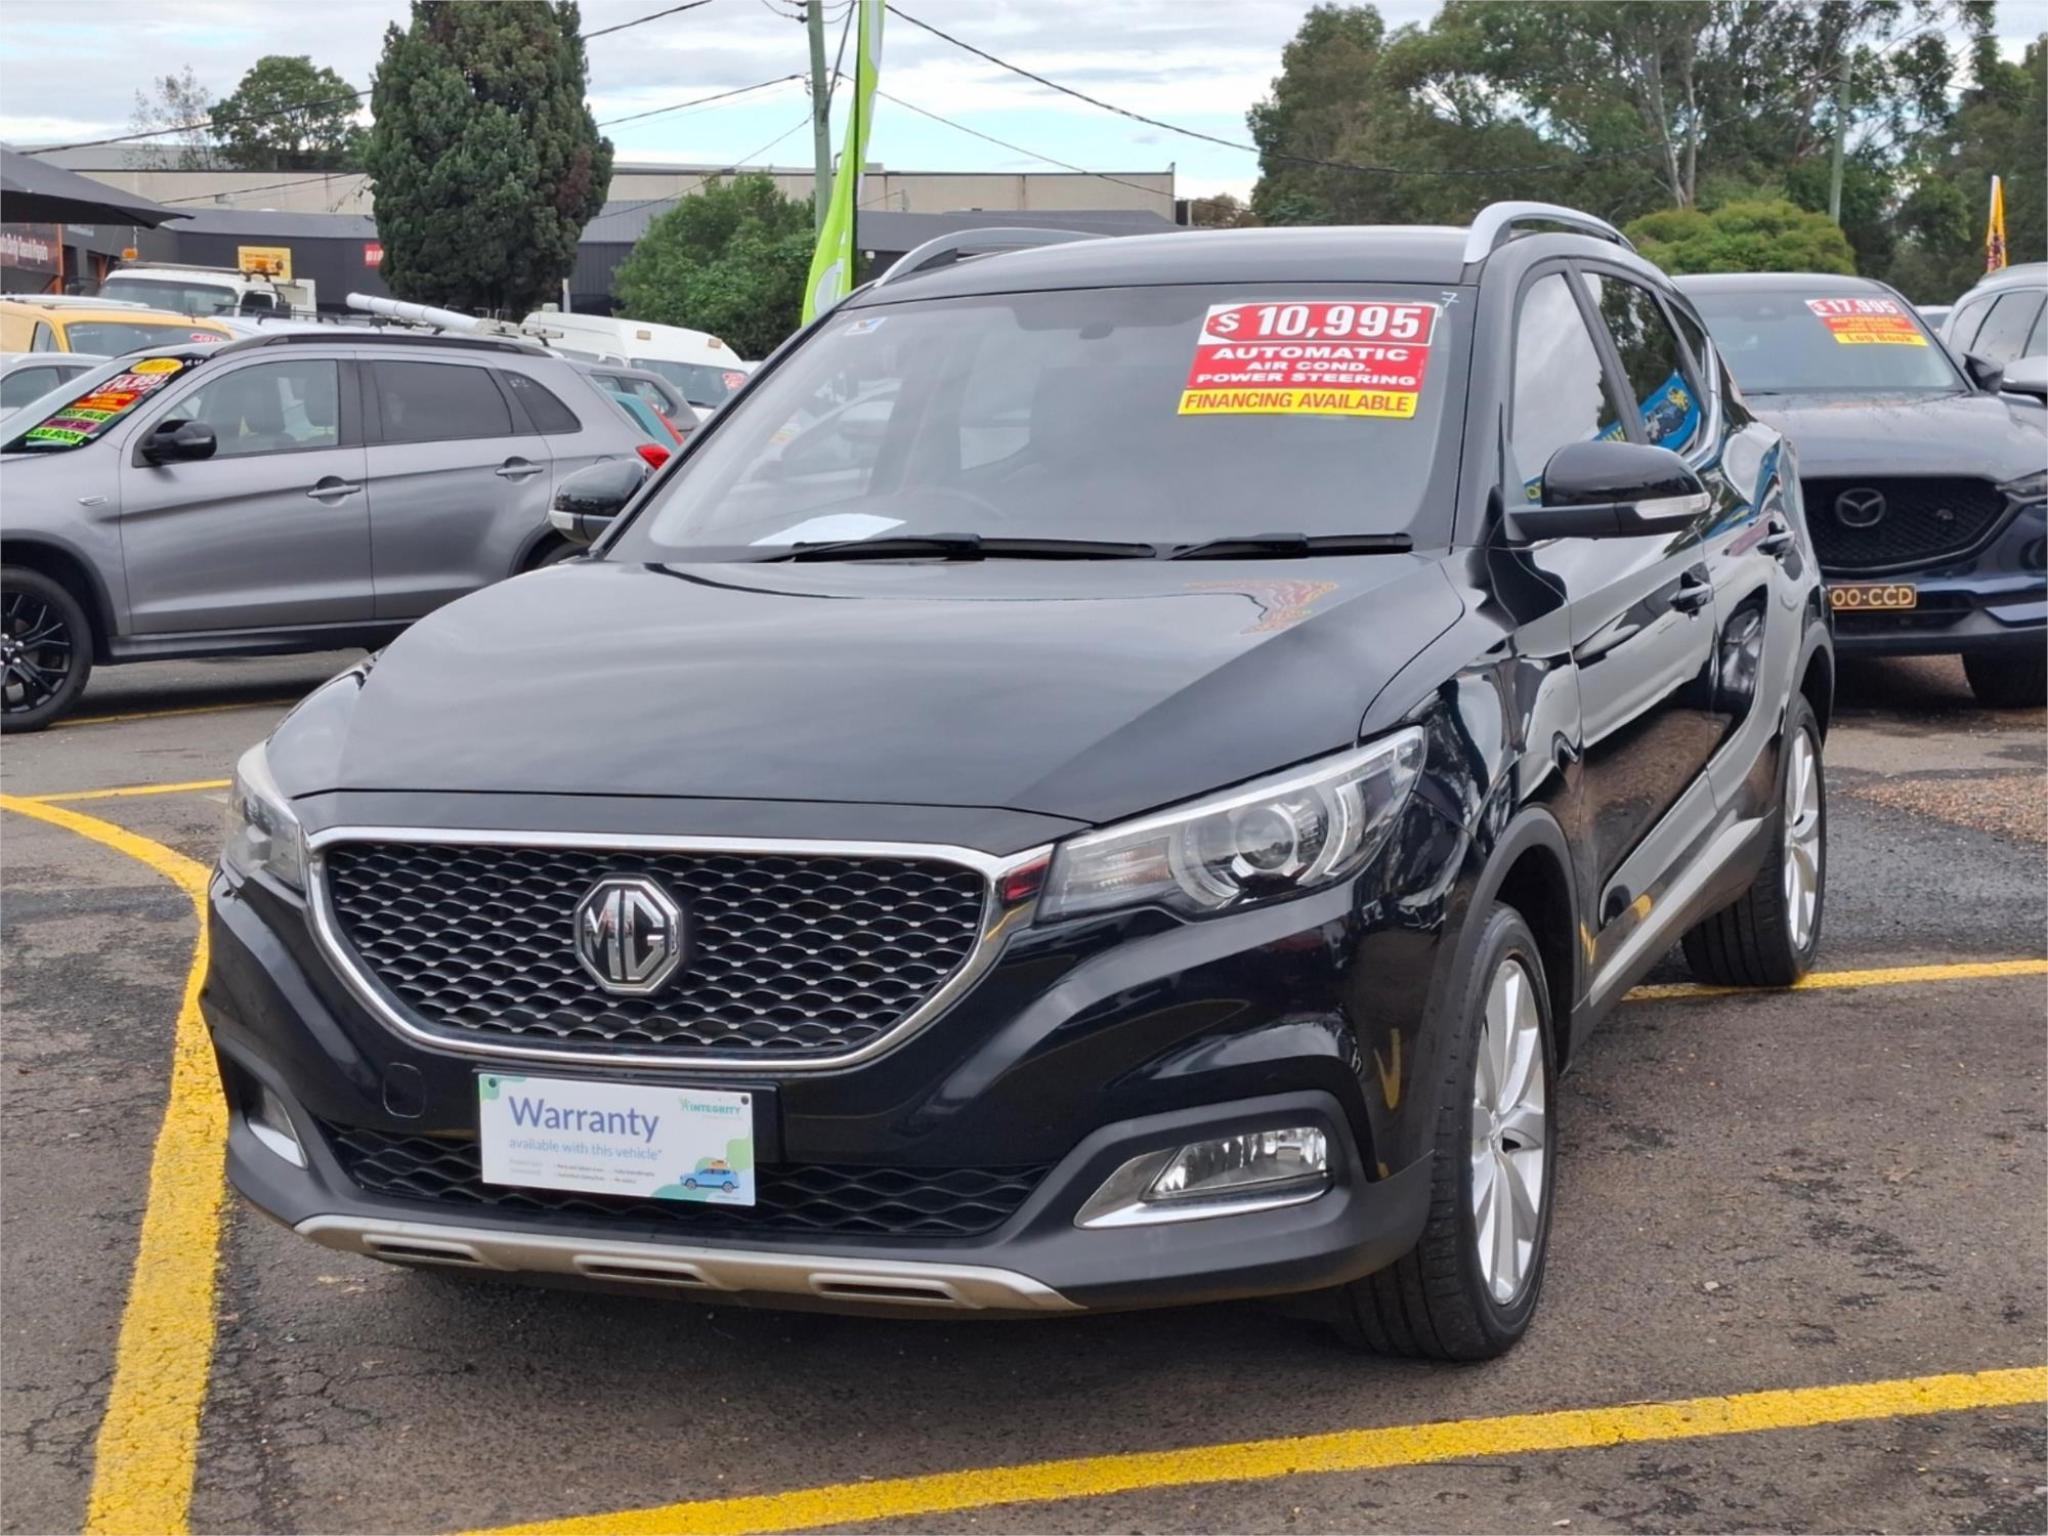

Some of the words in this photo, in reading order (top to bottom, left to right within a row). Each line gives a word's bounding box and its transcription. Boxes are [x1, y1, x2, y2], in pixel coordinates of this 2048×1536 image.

[1215, 313, 1240, 333] $
[1257, 305, 1422, 338] 10,995
[1211, 346, 1409, 361] AUTOMATIC
[1246, 361, 1288, 371] AIR
[1295, 361, 1371, 372] COND.
[1196, 373, 1283, 383] POWER
[1290, 373, 1416, 386] STEERING
[1185, 393, 1293, 409] FINANCING
[1297, 396, 1409, 412] AVAILABLE
[583, 889, 665, 980] MG
[508, 1096, 659, 1143] Warranty
[509, 1138, 559, 1151] available
[562, 1142, 588, 1154] with
[591, 1146, 613, 1157] this
